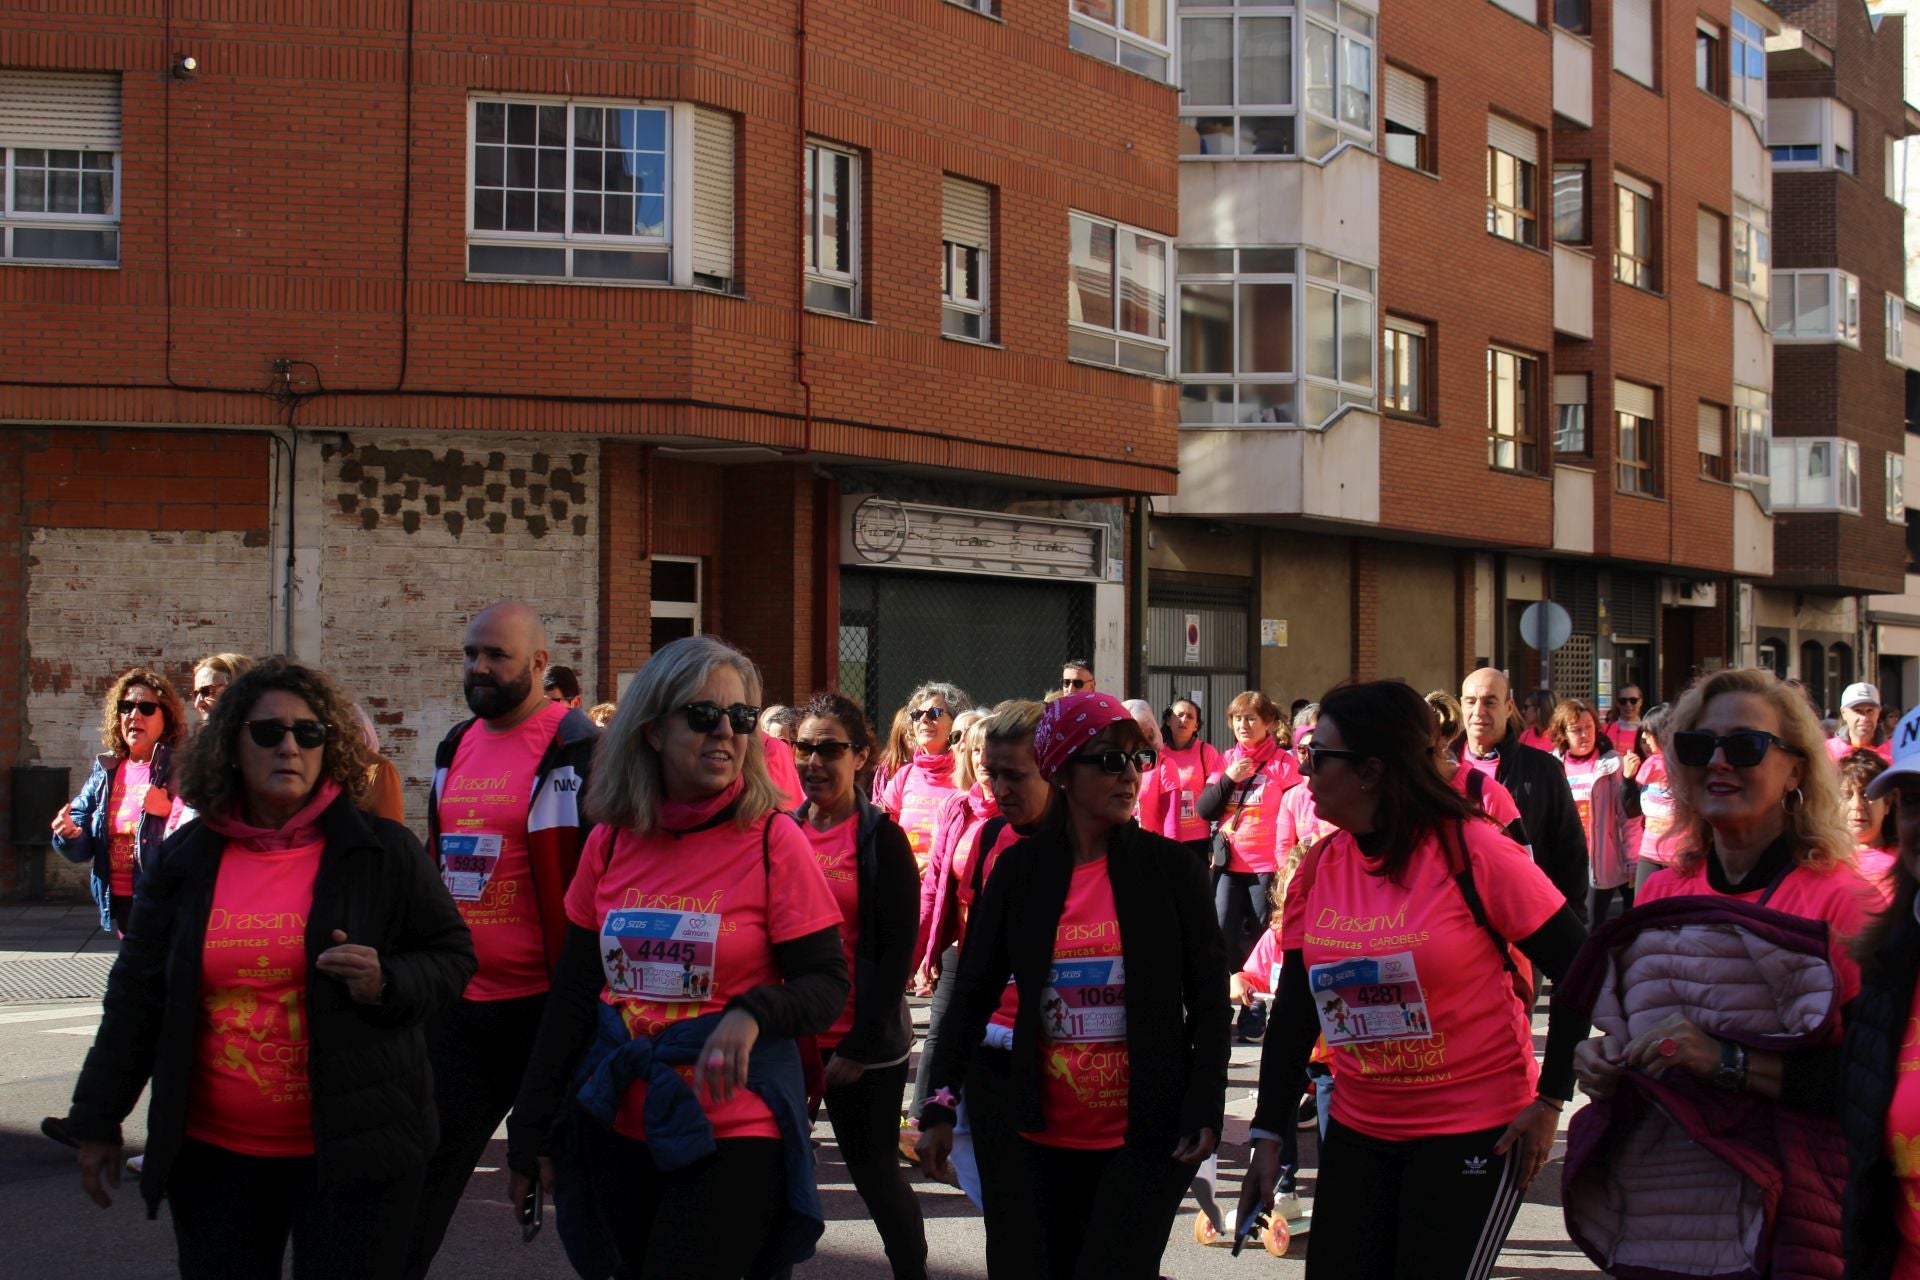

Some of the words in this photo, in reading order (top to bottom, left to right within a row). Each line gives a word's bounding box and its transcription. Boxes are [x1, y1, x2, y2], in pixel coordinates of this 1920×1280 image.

[453, 856, 487, 872] 5933
[637, 940, 696, 963] 4445
[237, 967, 292, 978] SUZUKI
[631, 967, 644, 990] 11
[1358, 985, 1401, 1004] 4287
[1070, 1014, 1084, 1036] 11
[1351, 1013, 1368, 1035] 11
